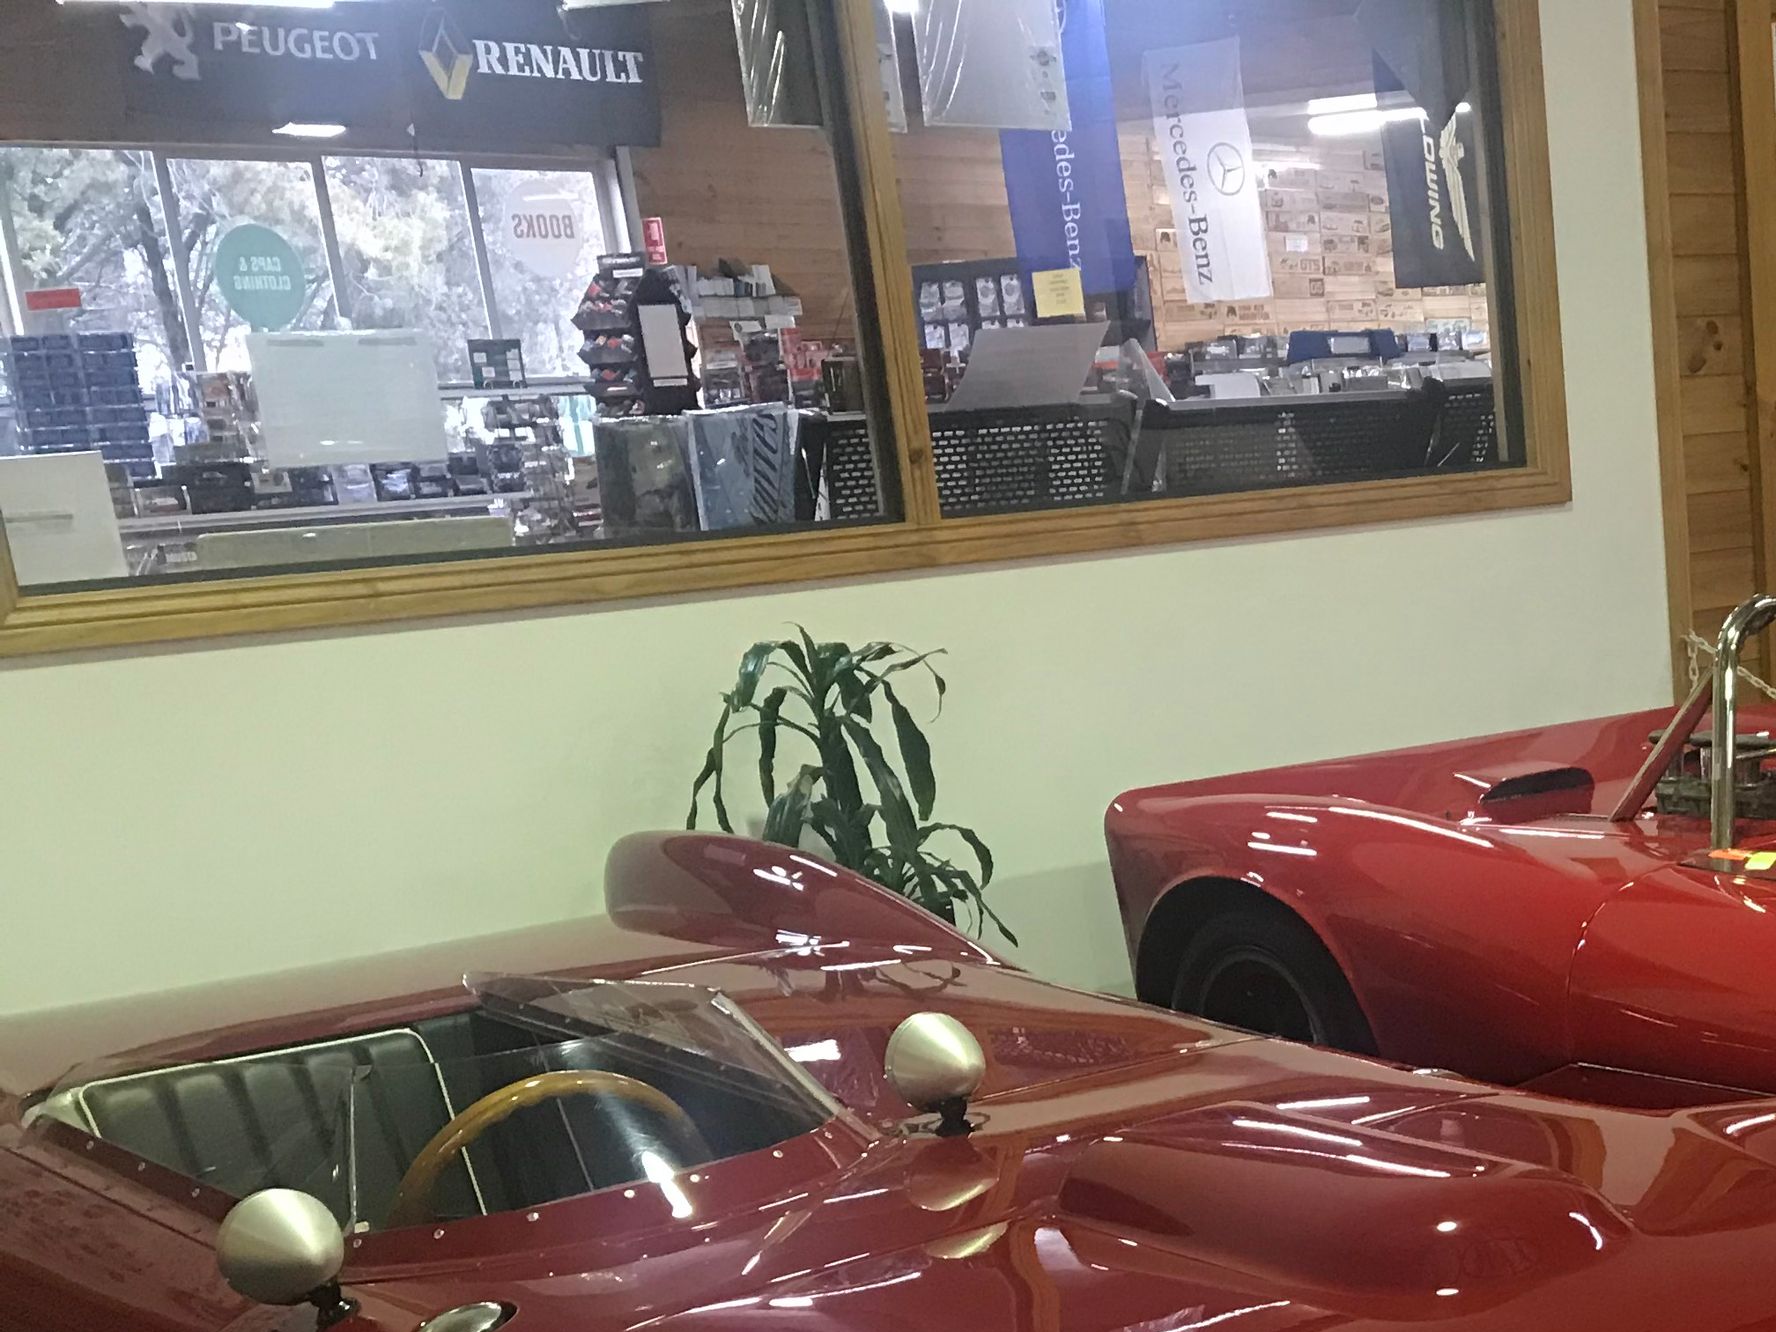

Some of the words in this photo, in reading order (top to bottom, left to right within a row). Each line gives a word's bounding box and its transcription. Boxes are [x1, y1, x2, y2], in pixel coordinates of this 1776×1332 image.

[213, 22, 379, 61] PEUGEOT
[472, 39, 644, 84] RENAULT
[1051, 129, 1081, 271] edes-Benz
[1162, 63, 1213, 285] Mercedes-Benz
